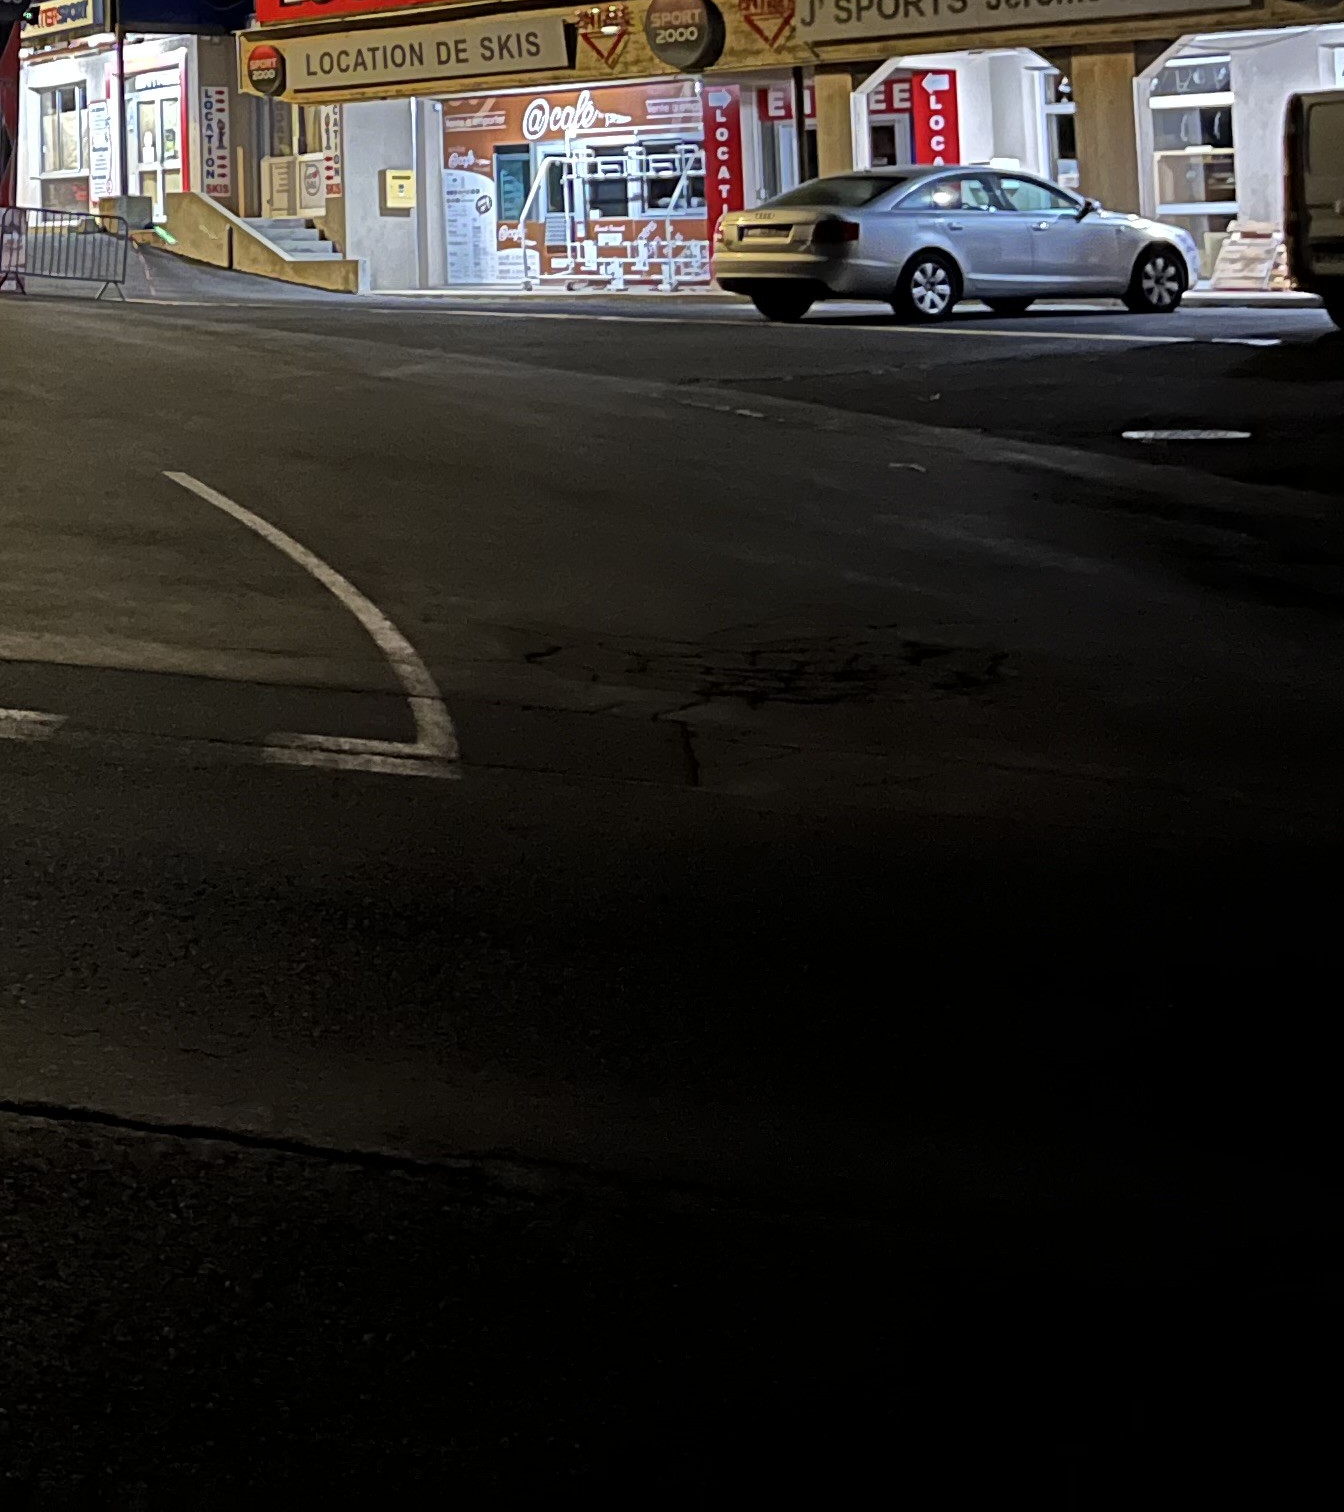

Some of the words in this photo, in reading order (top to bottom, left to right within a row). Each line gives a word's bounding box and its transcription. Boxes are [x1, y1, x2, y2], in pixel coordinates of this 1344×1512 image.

[650, 8, 703, 28] SPORT
[655, 26, 699, 44] 2000
[305, 40, 424, 77] LOCATION
[436, 38, 470, 66] DE
[480, 31, 542, 63] SKIS
[204, 88, 216, 180] LOCATION
